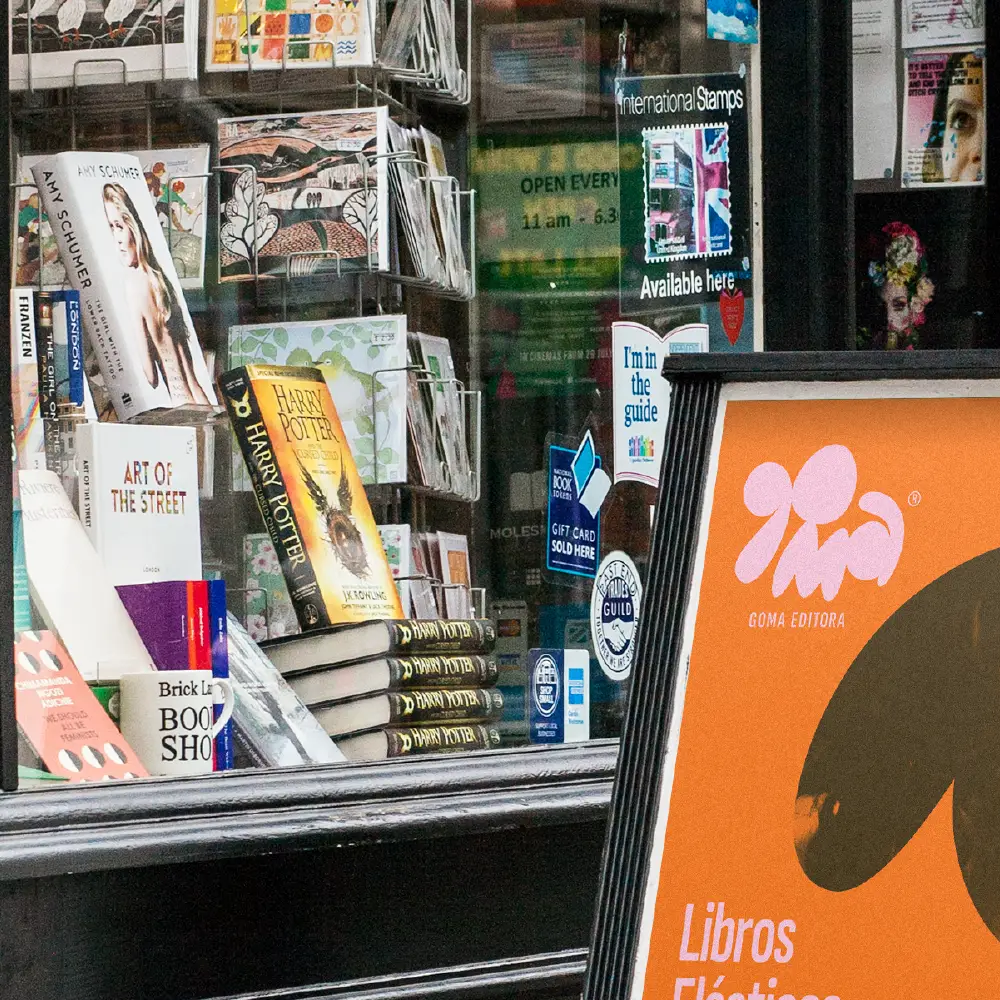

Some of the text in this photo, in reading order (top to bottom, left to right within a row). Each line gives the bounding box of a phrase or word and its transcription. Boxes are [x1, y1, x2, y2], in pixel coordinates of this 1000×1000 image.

[620, 85, 744, 116] International Stamps
[77, 165, 140, 180] AMY SCHUMER
[520, 176, 566, 194] OPEN
[545, 213, 571, 229] am
[594, 206, 619, 224] 6.3
[43, 170, 92, 289] AMY SCHUMER
[640, 268, 735, 300] Available here
[19, 296, 33, 358] FRANZEN
[70, 301, 81, 371] LONDON
[46, 332, 54, 360] THE
[624, 346, 643, 369] I'm
[645, 346, 657, 369] in
[47, 365, 56, 397] GIRL
[631, 371, 651, 396] the
[49, 401, 59, 422] ON
[272, 384, 326, 416] HARRY
[624, 399, 658, 428] guide
[278, 412, 340, 443] POTTER
[83, 475, 90, 486] OF
[123, 461, 173, 486] ART OF
[553, 475, 572, 492] BOOK
[110, 489, 187, 515] THE STREET
[245, 421, 282, 487] HARRY
[269, 492, 306, 572] POTTER
[490, 524, 546, 540] MOLES
[551, 522, 596, 542] GIFT CARD
[551, 540, 596, 560] SOLD HERE
[603, 602, 632, 616] GUILD
[748, 611, 845, 629] GOMA EDITORA
[408, 620, 473, 640] HARRY POTTER
[410, 656, 475, 675] HARRY POTTER
[158, 680, 198, 697] Brick
[412, 689, 480, 709] HARRY POTTER
[540, 685, 553, 695] SHOP
[158, 706, 213, 731] BOO
[410, 726, 477, 747] HARRY POTTER
[679, 901, 797, 963] Libros
